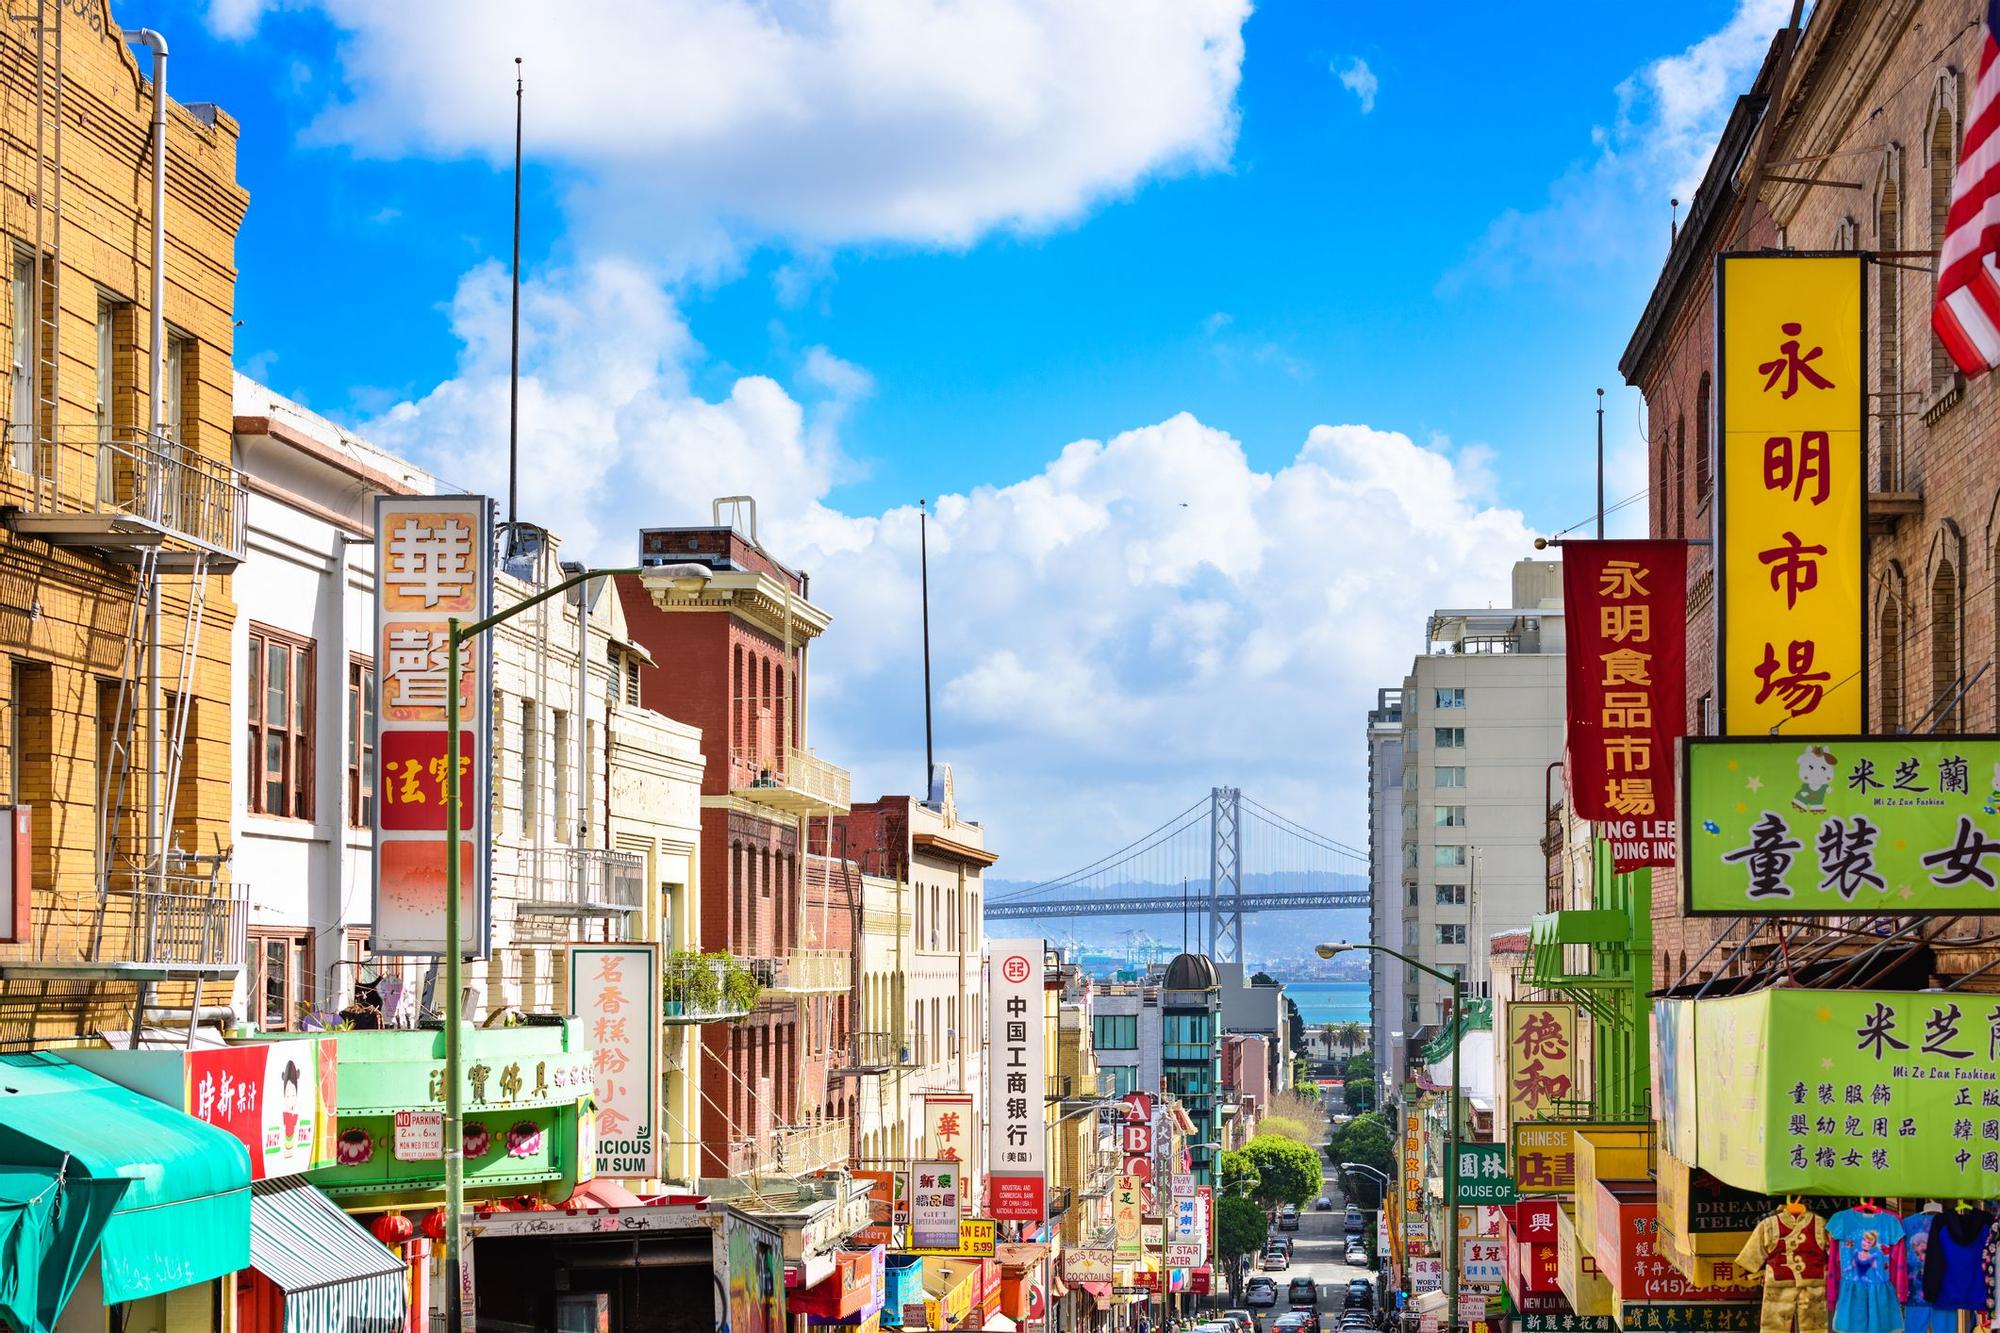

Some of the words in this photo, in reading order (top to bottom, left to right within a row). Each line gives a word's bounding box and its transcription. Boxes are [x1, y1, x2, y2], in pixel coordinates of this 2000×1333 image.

[1754, 322, 1836, 718] 永明市場
[1599, 559, 1656, 817] 永明食品市場
[1848, 754, 1969, 796] 米芝蘭
[1873, 797, 1885, 806] Mi
[1724, 812, 1885, 899] 童裝
[1857, 1001, 2000, 1062] 米芝
[1006, 995, 1028, 1146] 中国工商银行
[1513, 1011, 1572, 1121] 德和
[1892, 1066, 1908, 1078] Mi
[1929, 1066, 1950, 1079] Lan
[1954, 1068, 1996, 1080] Fashion
[198, 1070, 257, 1123] 時新果汁
[1788, 1082, 1892, 1105] 童裝服飾
[397, 1113, 409, 1126] NO
[411, 1116, 440, 1125] PARKING
[1519, 1131, 1568, 1147] CHINESE
[596, 1140, 651, 1155] ICIOUS
[613, 1158, 646, 1172] SUM
[1496, 1185, 1511, 1198] OF
[1697, 1200, 1772, 1214] DREAM
[1528, 1213, 1554, 1232] 興
[974, 1226, 992, 1237] EAT
[973, 1242, 993, 1251] 5.99
[1177, 1246, 1198, 1255] STAR
[1088, 1251, 1111, 1267] PLACE
[1156, 1256, 1191, 1265] EATER
[1066, 1272, 1111, 1281] COCKTAILS
[1524, 1297, 1541, 1309] NEW
[1543, 1297, 1556, 1309] LAI
